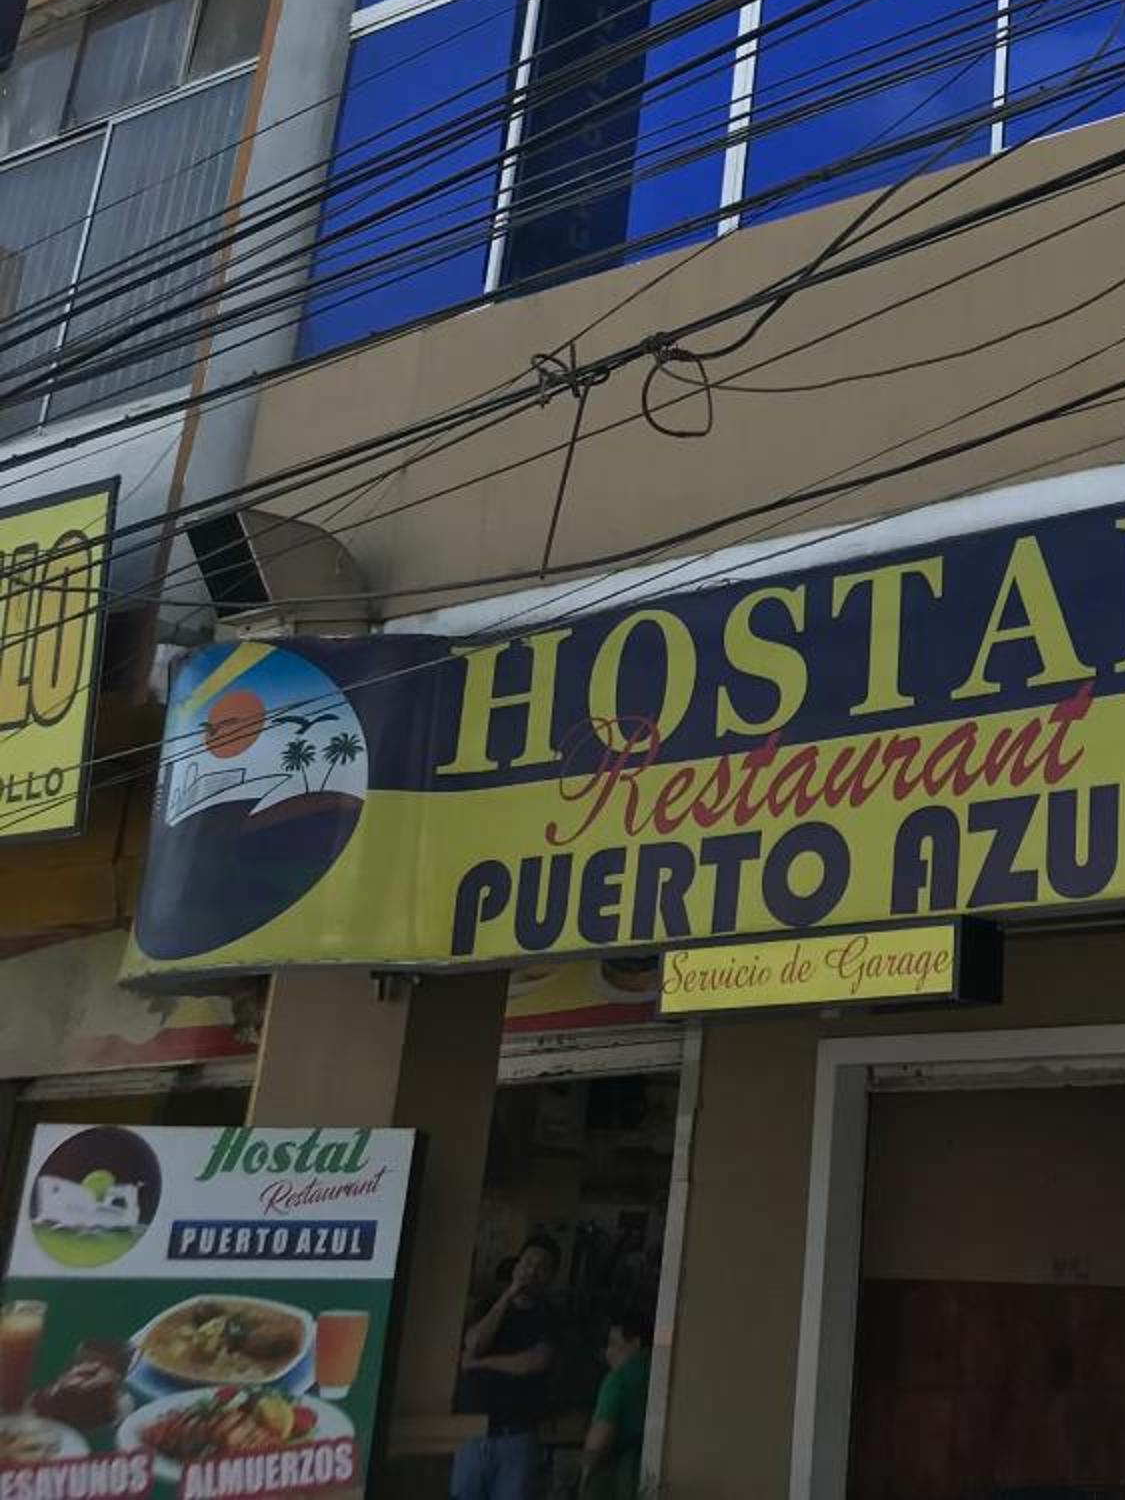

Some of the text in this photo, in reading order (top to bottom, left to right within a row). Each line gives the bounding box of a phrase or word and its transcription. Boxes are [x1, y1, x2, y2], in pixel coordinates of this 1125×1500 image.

[545, 682, 1095, 847] Restaurant
[452, 821, 852, 956] PUERTO
[661, 935, 949, 995] Servicio de Garage
[195, 1127, 374, 1182] Hostal
[260, 1166, 392, 1216] Restaurant
[180, 1225, 364, 1255] PUERTO AZUL
[184, 1444, 355, 1500] ALMUERZOS
